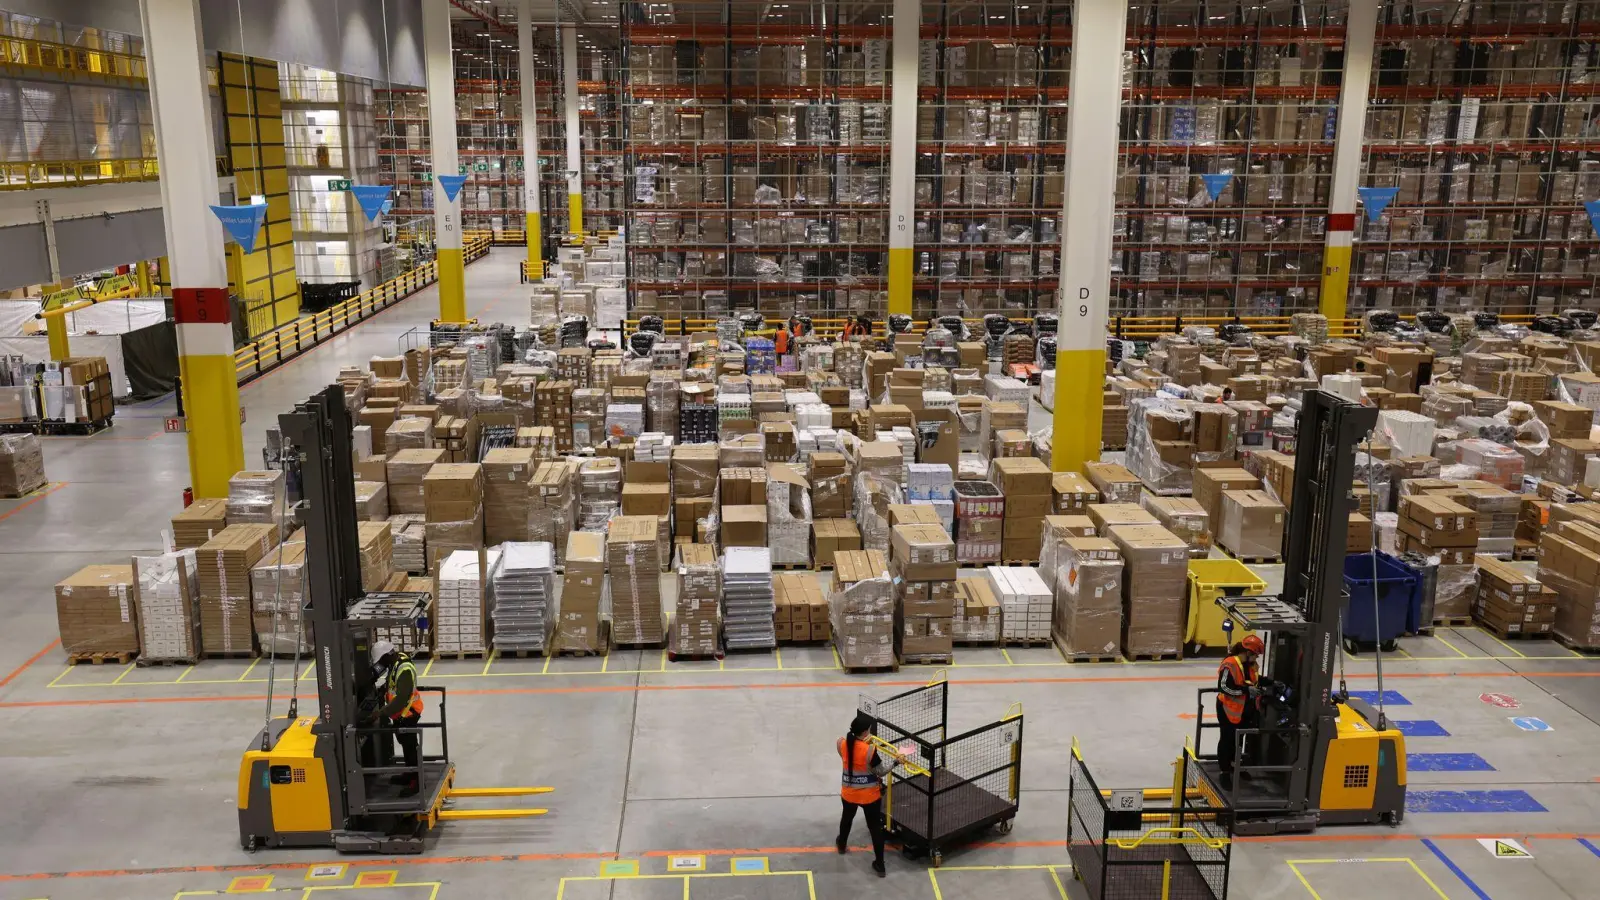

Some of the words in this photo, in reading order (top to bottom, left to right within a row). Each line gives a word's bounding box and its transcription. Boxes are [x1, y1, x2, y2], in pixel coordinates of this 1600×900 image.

[196, 290, 205, 302] E
[1079, 287, 1090, 300] D
[198, 308, 207, 320] 9
[1079, 304, 1088, 317] 9
[1321, 631, 1333, 675] JUNGHEINRICH
[323, 645, 334, 690] JUNGHEINRICH
